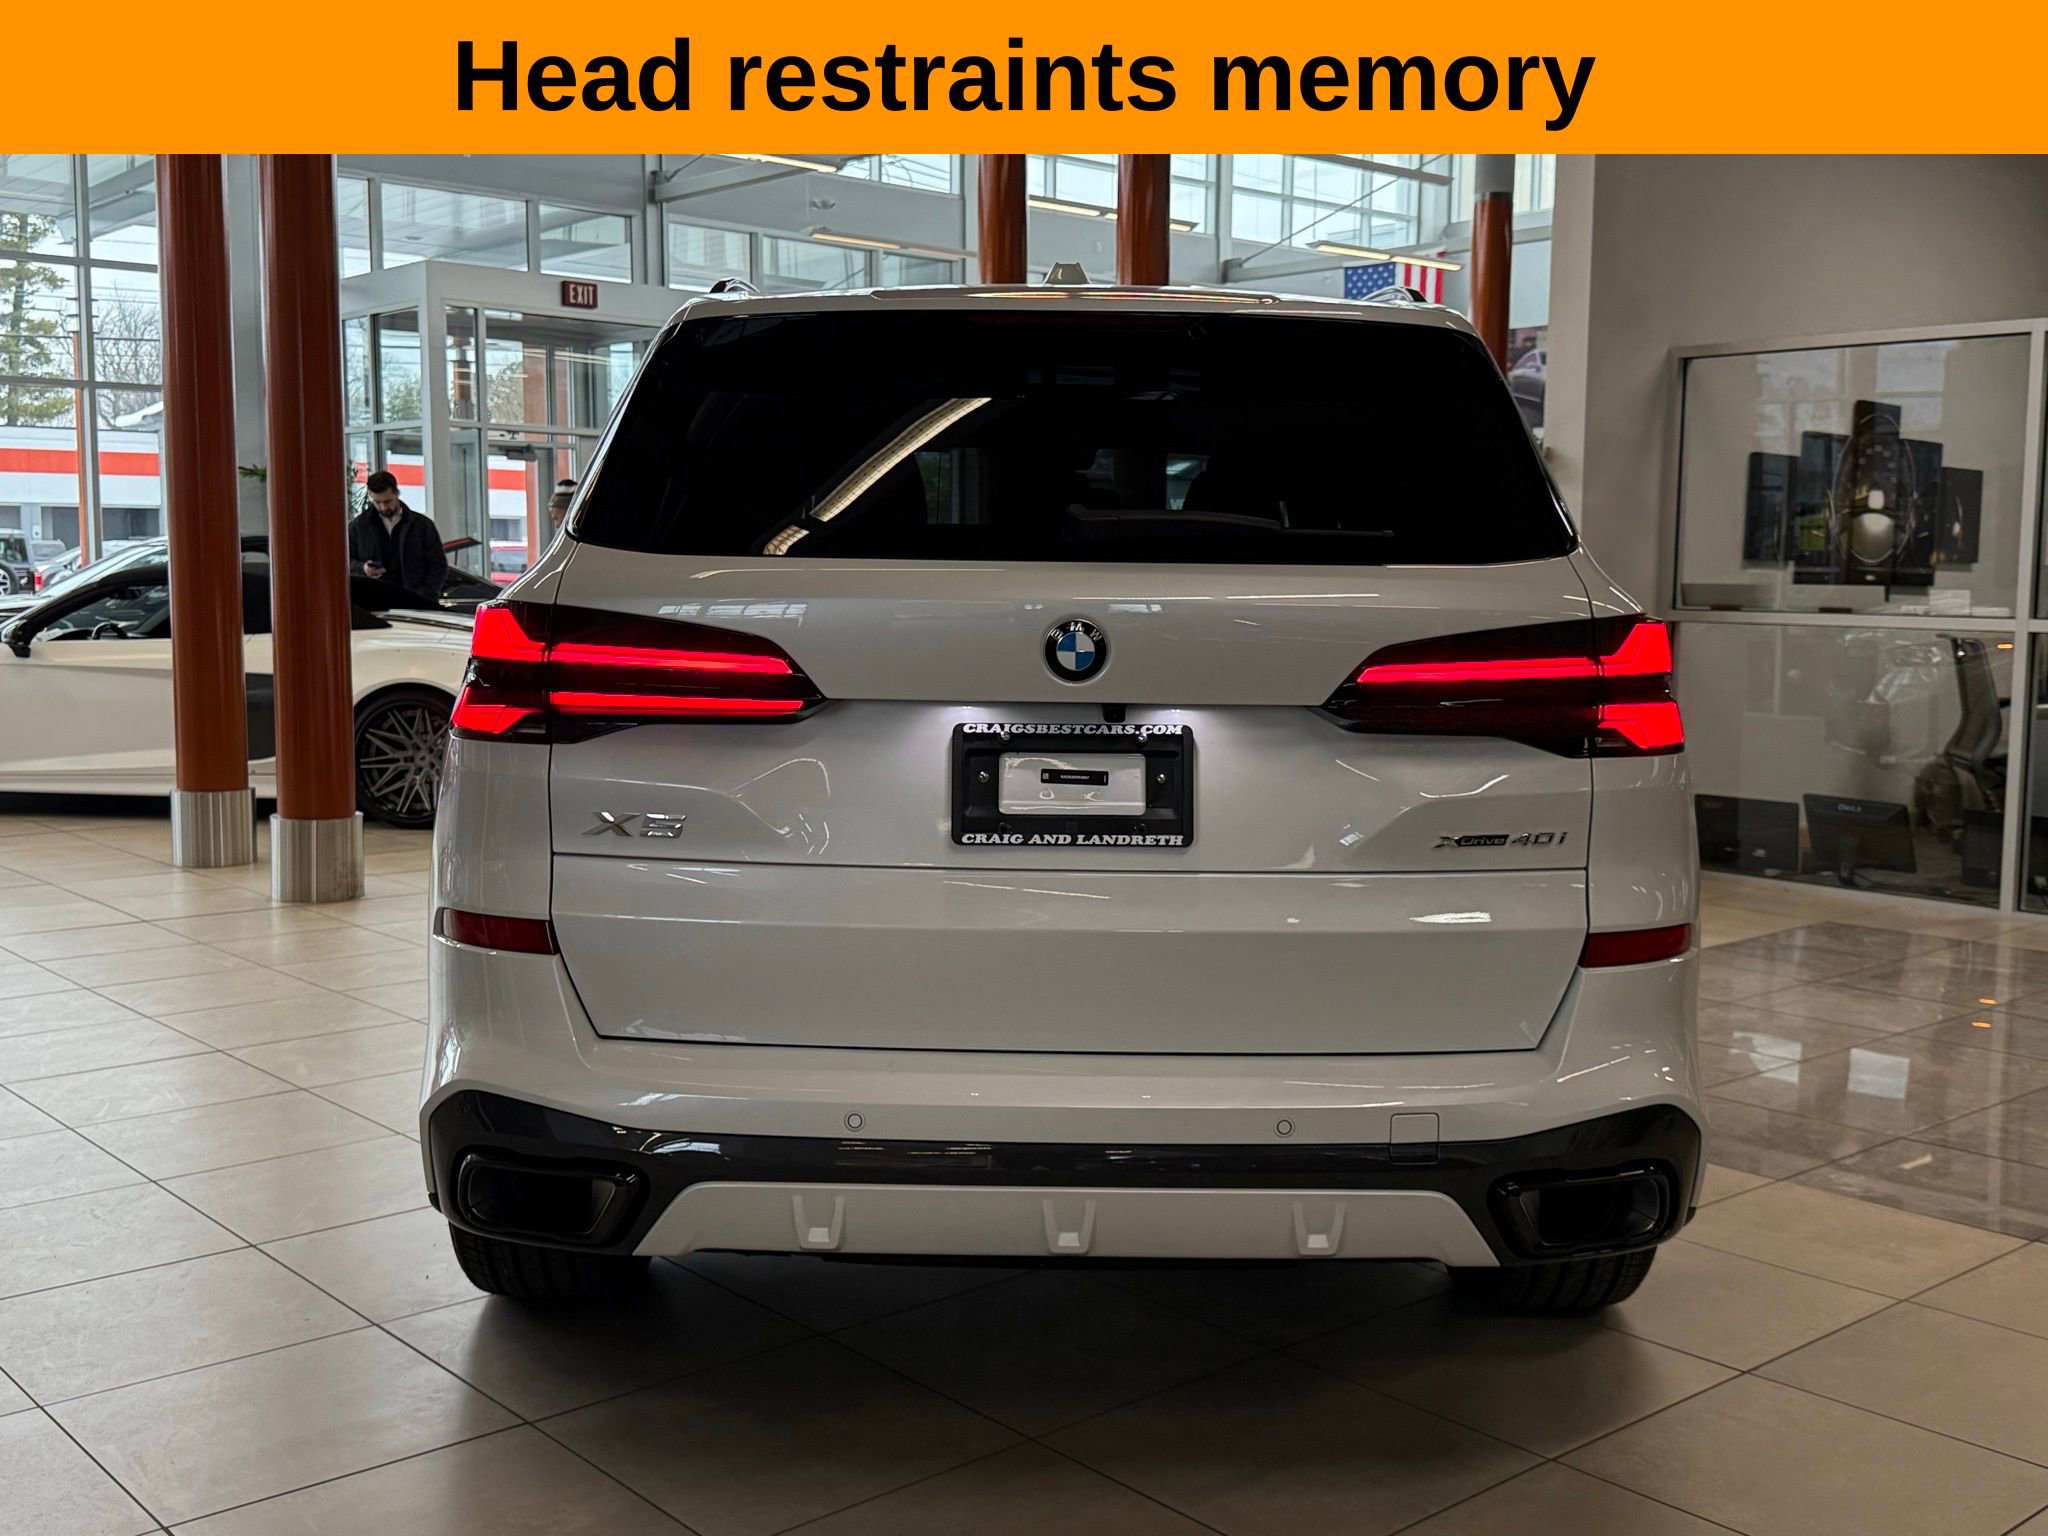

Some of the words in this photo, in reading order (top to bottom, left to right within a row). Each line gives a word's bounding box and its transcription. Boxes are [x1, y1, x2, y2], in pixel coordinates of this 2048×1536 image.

[569, 283, 594, 305] EXIT
[1051, 621, 1102, 641] BMW
[963, 723, 1183, 735] CRAIGSBESTCARS.COM
[581, 811, 686, 838] X5
[961, 833, 1024, 844] CRAIG
[1028, 834, 1072, 845] AND
[1076, 834, 1184, 846] LANDRETH
